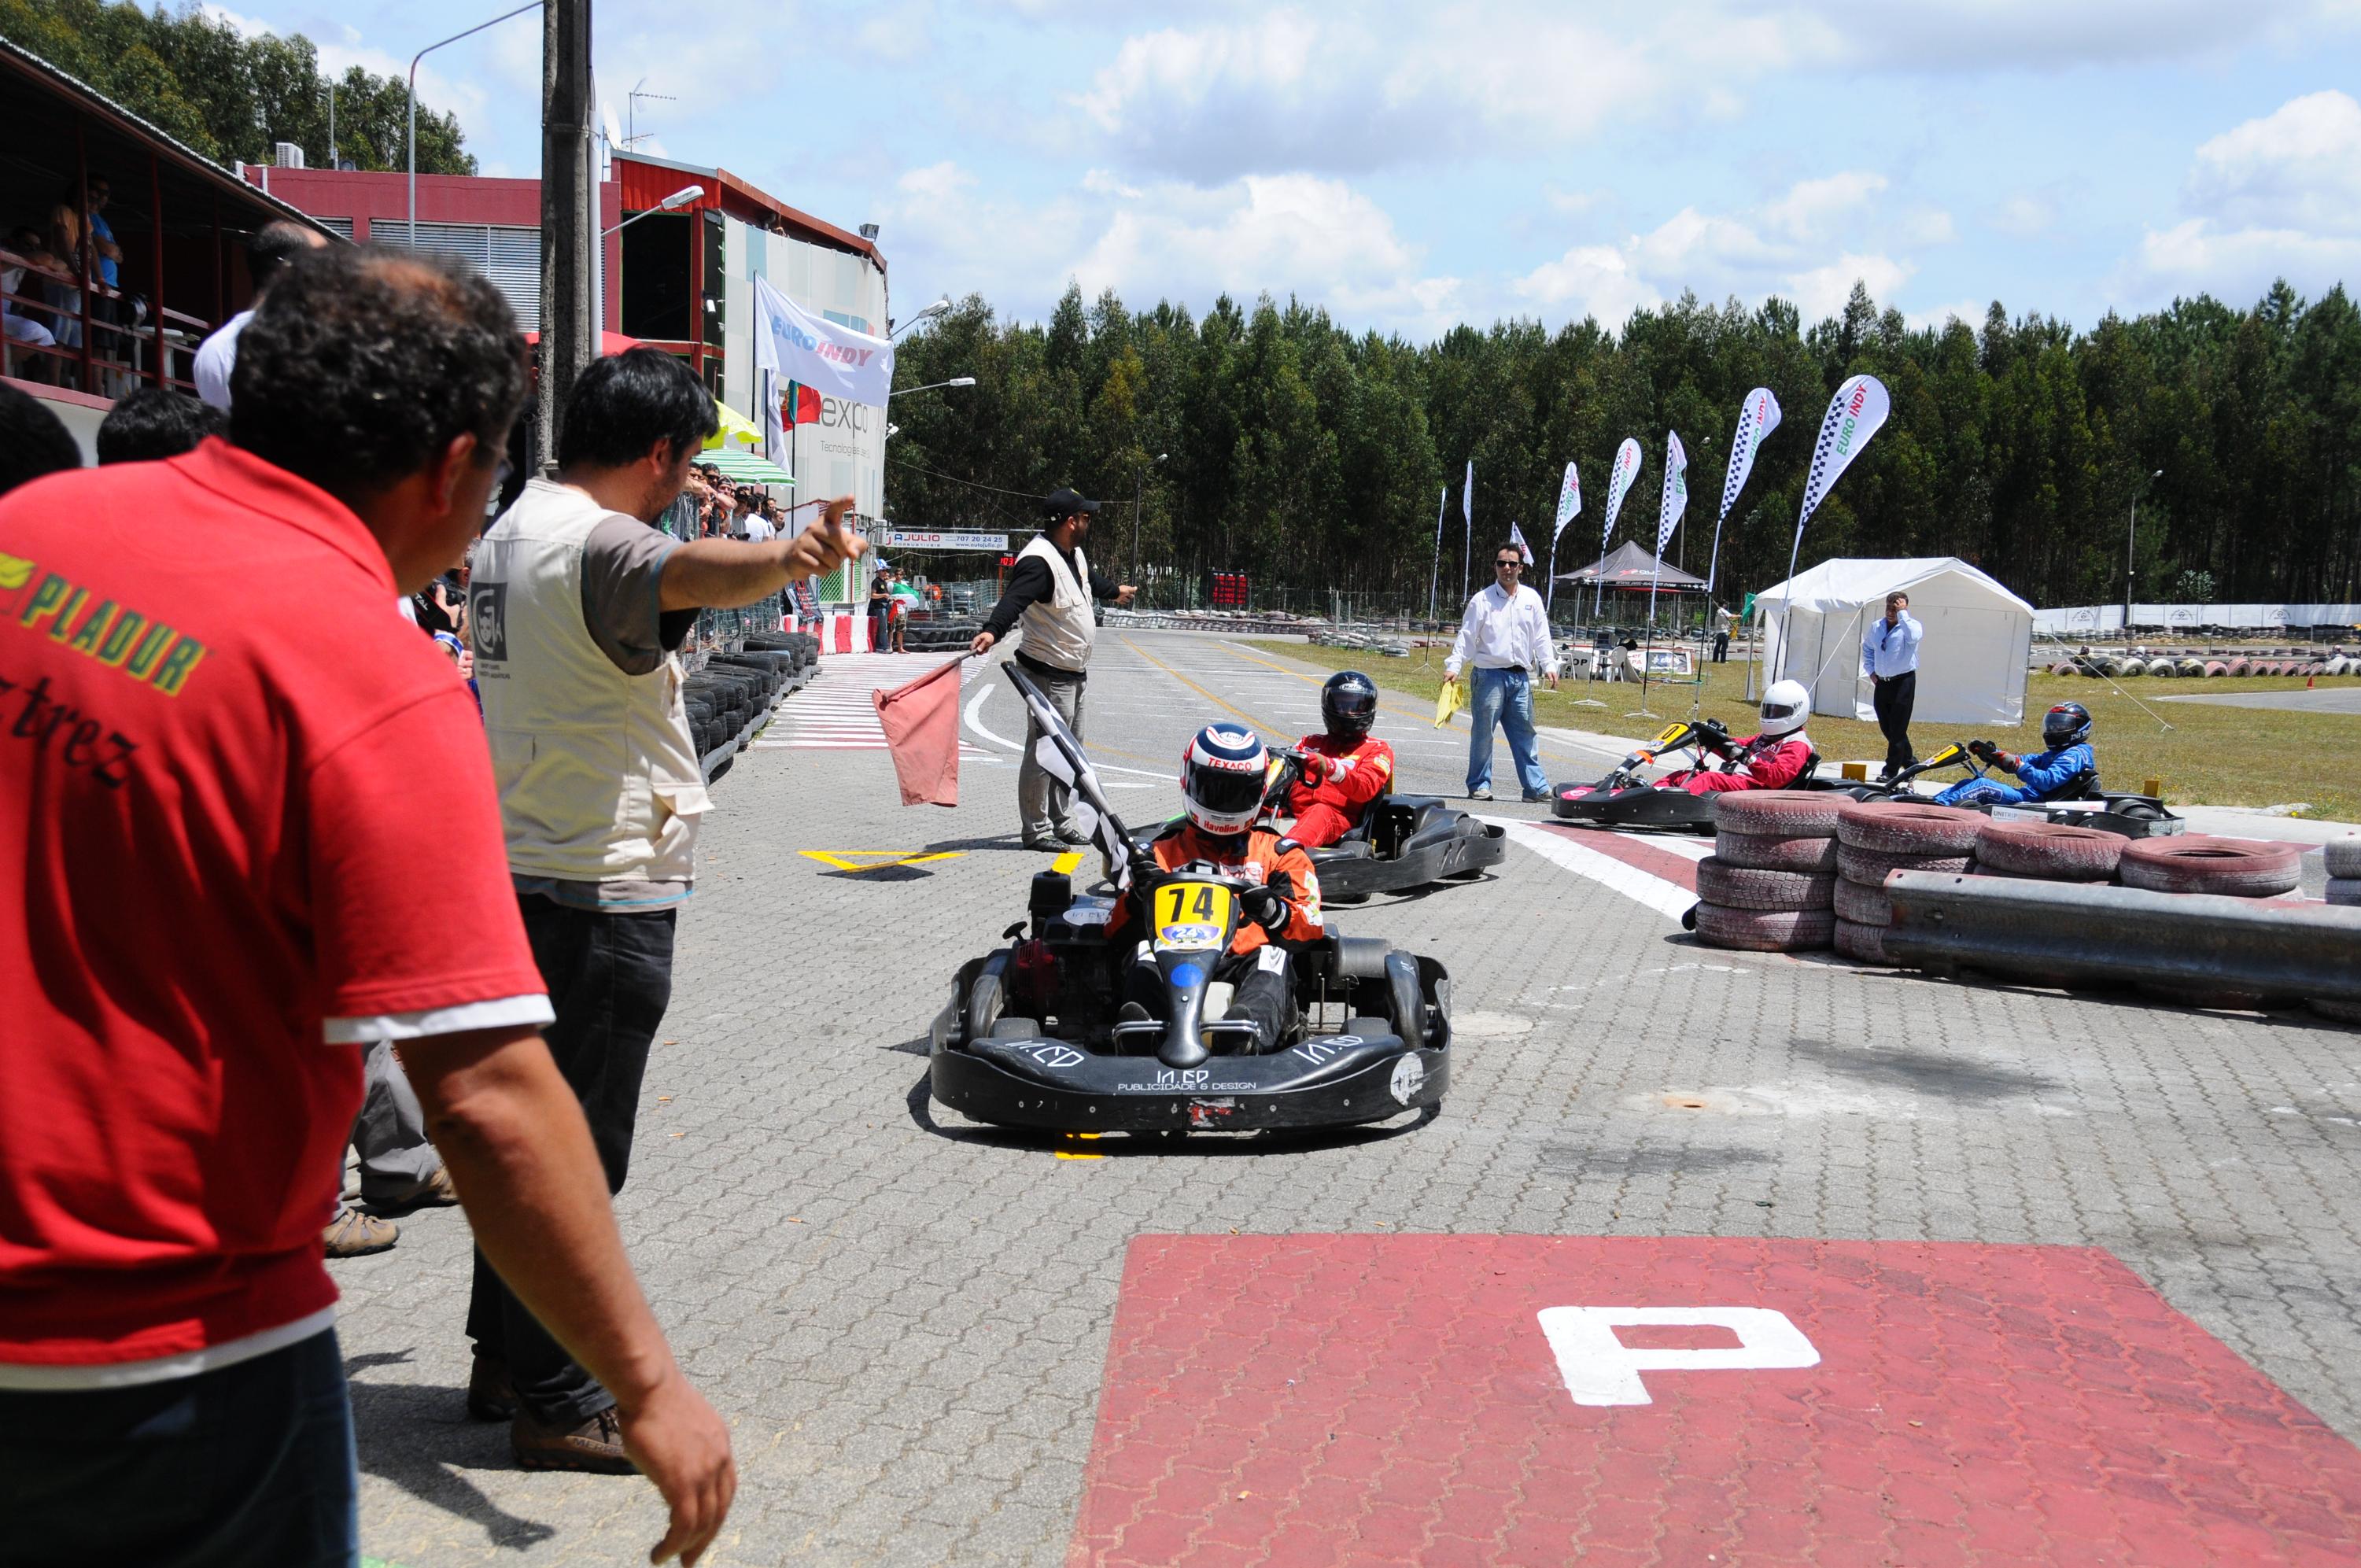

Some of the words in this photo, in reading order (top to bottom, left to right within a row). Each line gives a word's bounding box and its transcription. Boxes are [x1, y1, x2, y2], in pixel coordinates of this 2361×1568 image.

[1835, 418, 1856, 456] EURO
[1848, 383, 1868, 418] INDY
[1623, 445, 1633, 470] INDY
[20, 572, 207, 698] PLADUR
[1208, 757, 1252, 771] TEXACO
[1204, 821, 1239, 833] Havoline
[1169, 887, 1213, 923] 74
[1199, 1083, 1209, 1091] &
[1212, 1082, 1257, 1091] DESIGN
[1536, 1306, 1821, 1407] P
